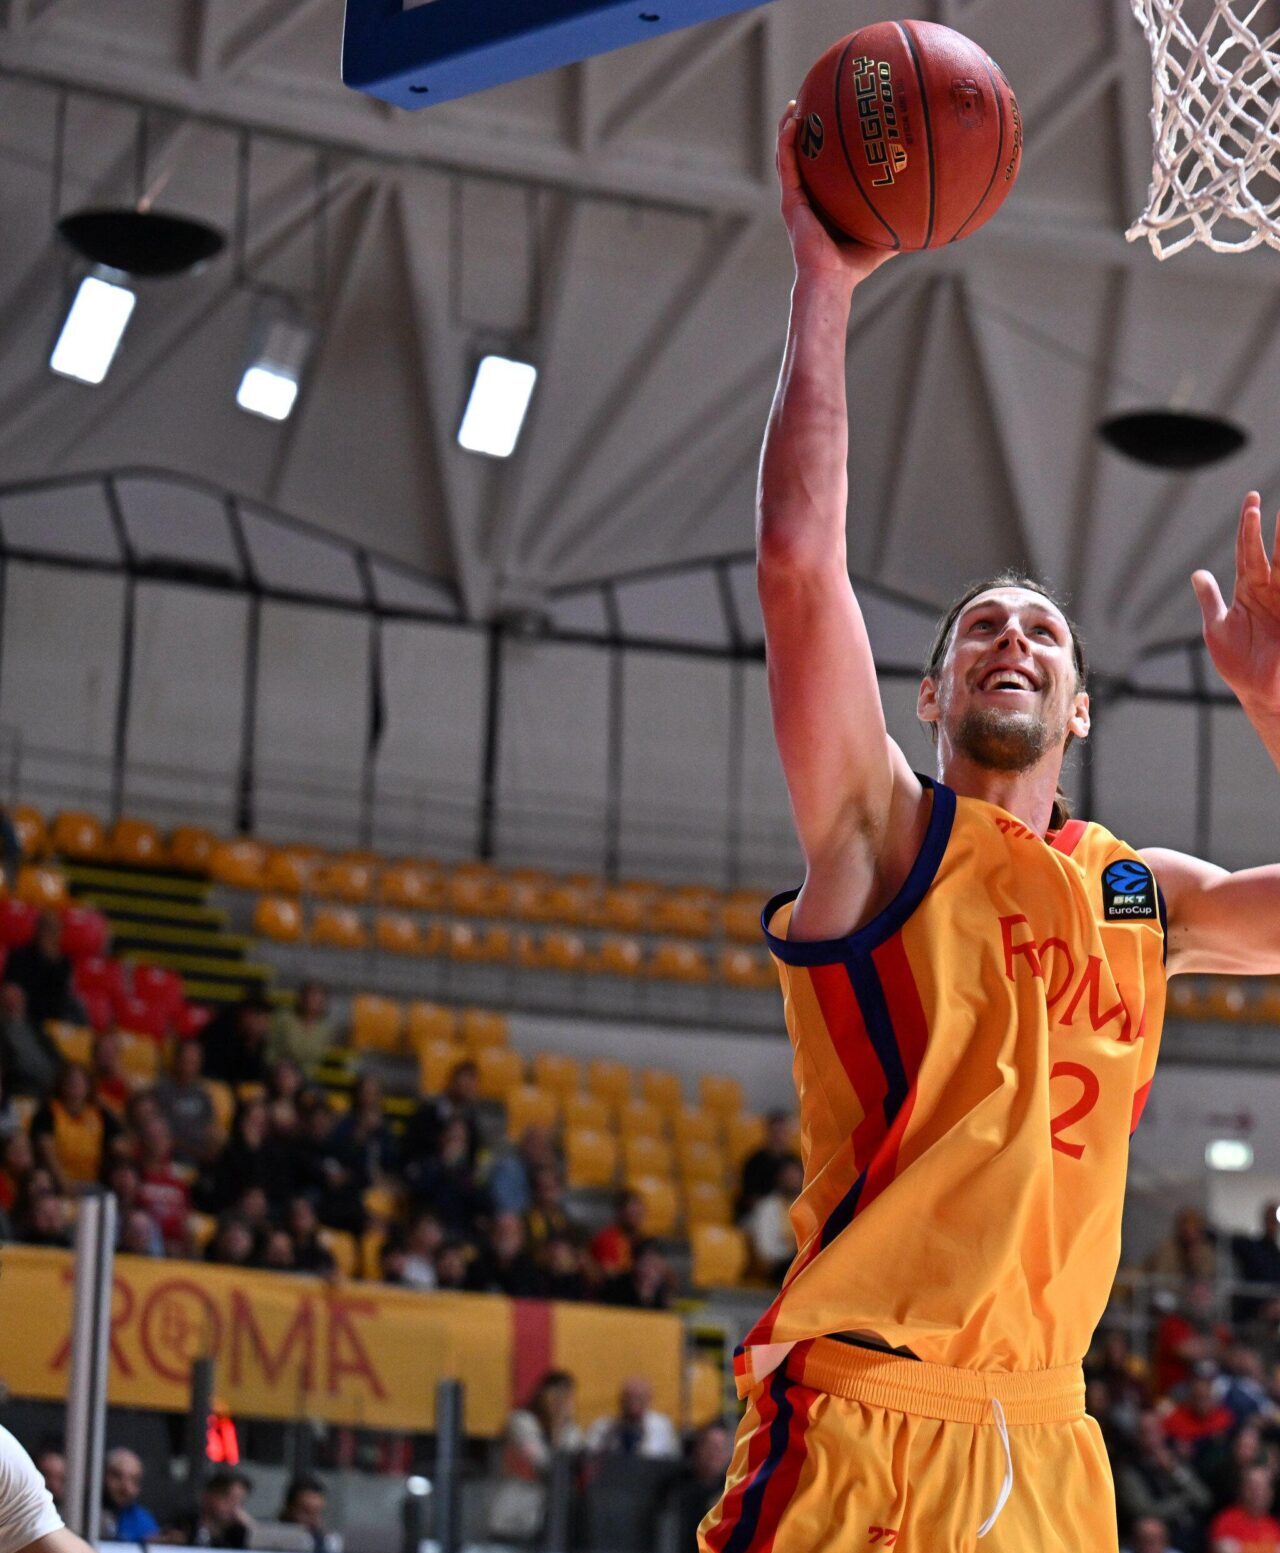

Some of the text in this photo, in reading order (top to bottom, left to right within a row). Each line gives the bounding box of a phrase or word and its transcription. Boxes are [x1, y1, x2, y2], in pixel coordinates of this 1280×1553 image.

[852, 56, 895, 187] LEGACY
[877, 61, 900, 140] 1000
[1108, 905, 1153, 916] EuroCup
[1112, 894, 1146, 905] BKT
[998, 913, 1146, 1042] ROM
[1050, 1061, 1100, 1161] 2
